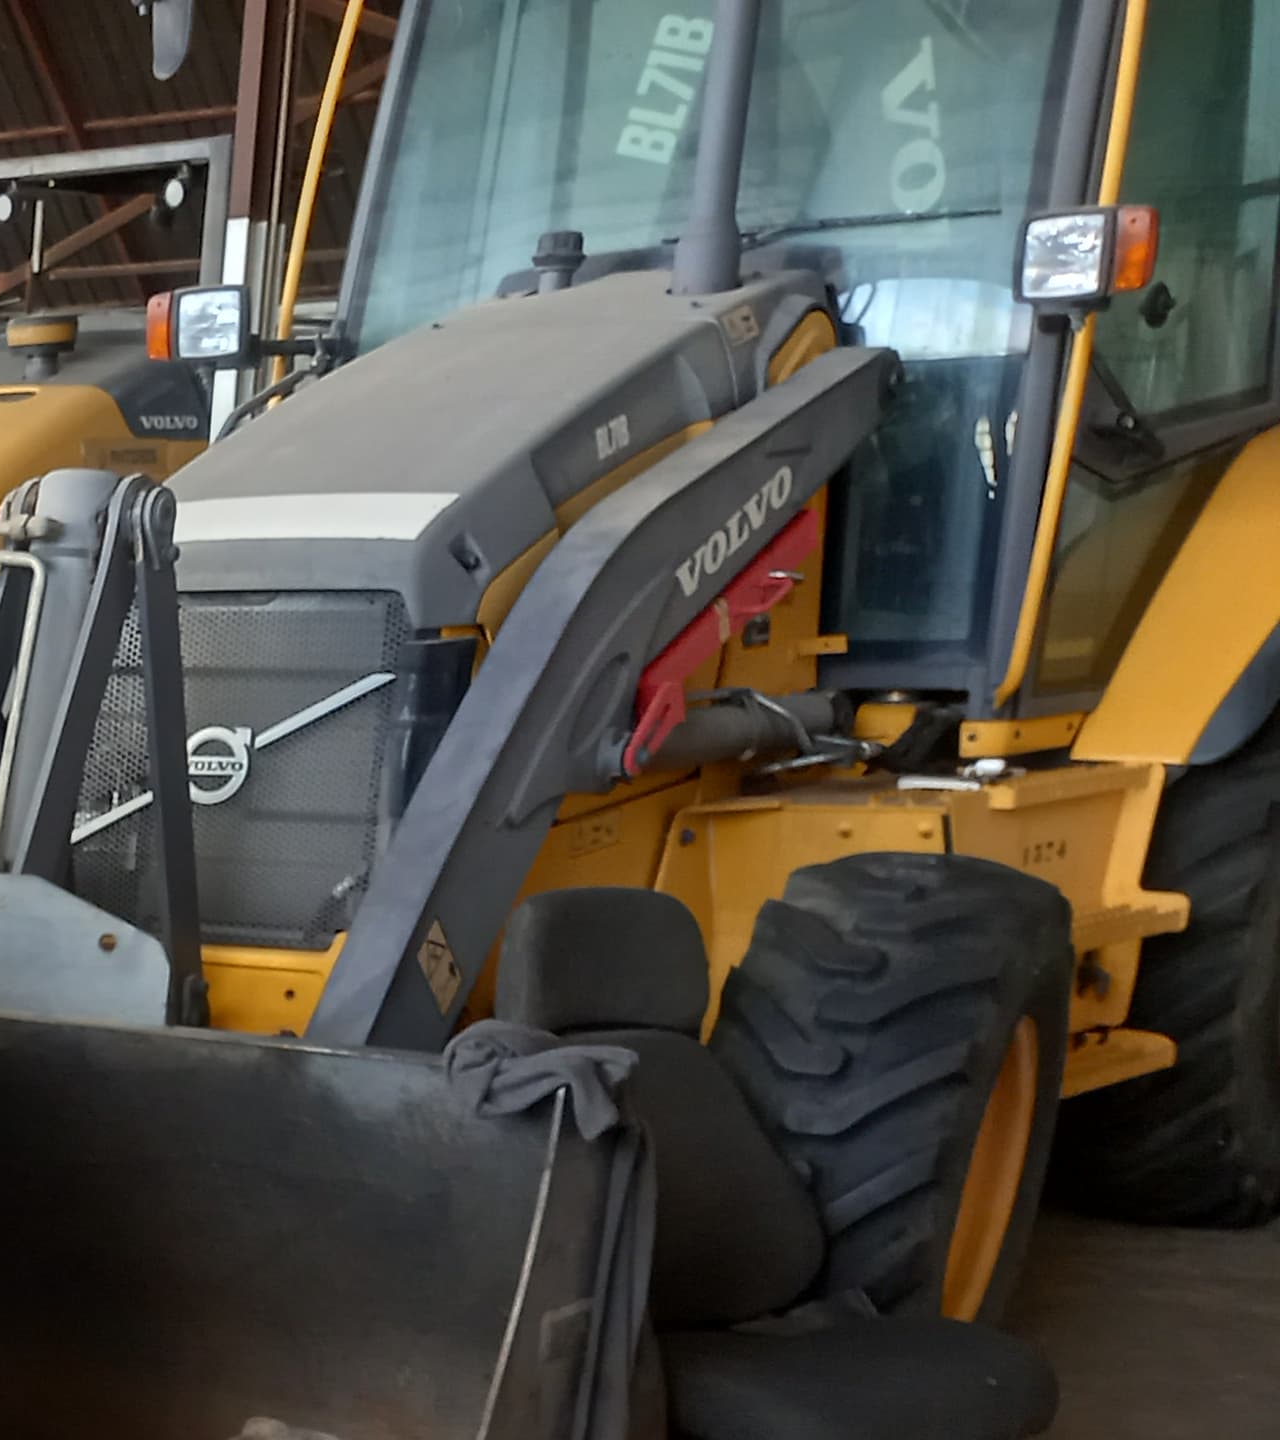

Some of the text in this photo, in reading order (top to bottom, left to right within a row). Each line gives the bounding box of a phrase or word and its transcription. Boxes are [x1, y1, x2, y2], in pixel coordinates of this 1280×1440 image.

[616, 14, 714, 165] BL71B
[140, 416, 198, 430] VOLVO
[675, 465, 793, 597] VOLVO
